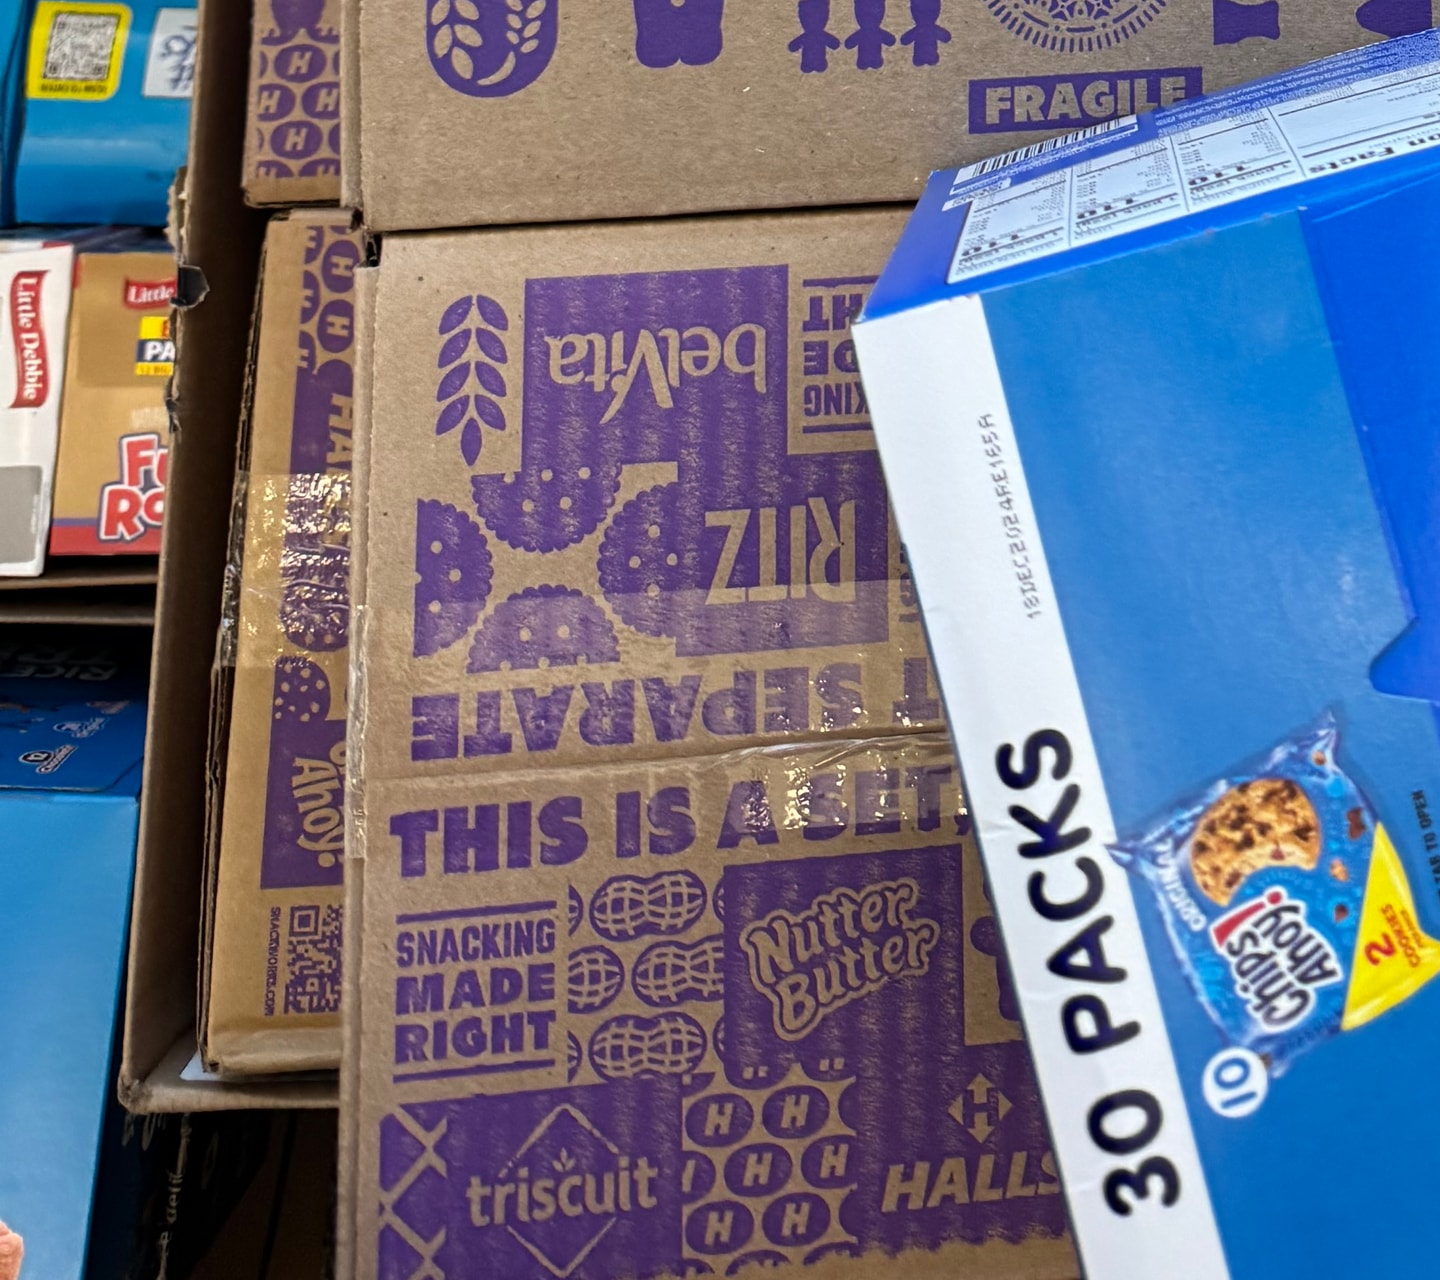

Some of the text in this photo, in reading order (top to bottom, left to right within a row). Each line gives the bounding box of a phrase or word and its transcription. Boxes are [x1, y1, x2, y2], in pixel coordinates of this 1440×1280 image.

[984, 75, 1187, 127] FRAGILE
[127, 284, 175, 304] Little
[17, 276, 46, 402] Little Debbie
[543, 321, 768, 425] belVita
[703, 496, 857, 607] RITZ
[411, 659, 864, 762] SEPARATE
[389, 765, 974, 879] THIS IS SET,
[1411, 789, 1433, 824] OPEN
[395, 916, 558, 967] SNACKING
[747, 880, 918, 974] Nutter
[1366, 927, 1395, 968] 2
[1380, 903, 1423, 968] COOKIES
[395, 962, 557, 1015] MADE
[776, 919, 939, 1034] Butter
[995, 727, 1181, 1218] 30 PACKS
[395, 1010, 557, 1066] RIGHT
[1211, 1054, 1260, 1108] 10
[465, 1151, 659, 1229] triscuit
[882, 1148, 1062, 1213] HALLS
